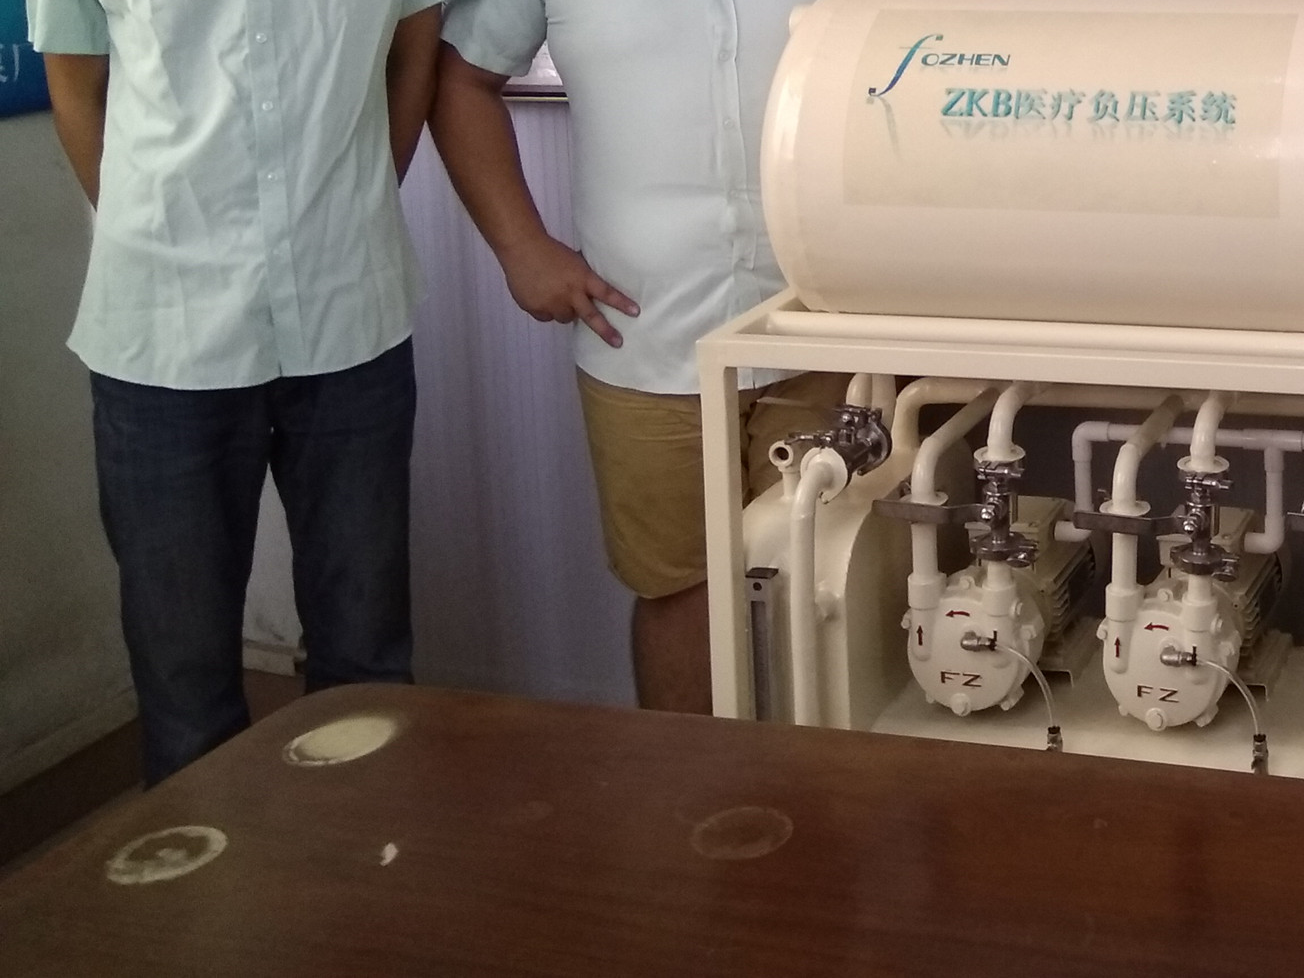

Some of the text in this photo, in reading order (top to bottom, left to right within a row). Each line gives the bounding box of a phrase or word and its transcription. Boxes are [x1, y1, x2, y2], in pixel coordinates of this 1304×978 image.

[940, 86, 1237, 125] ZKB医疗负压系统
[939, 670, 983, 689] FZ
[1136, 684, 1180, 704] FZ
